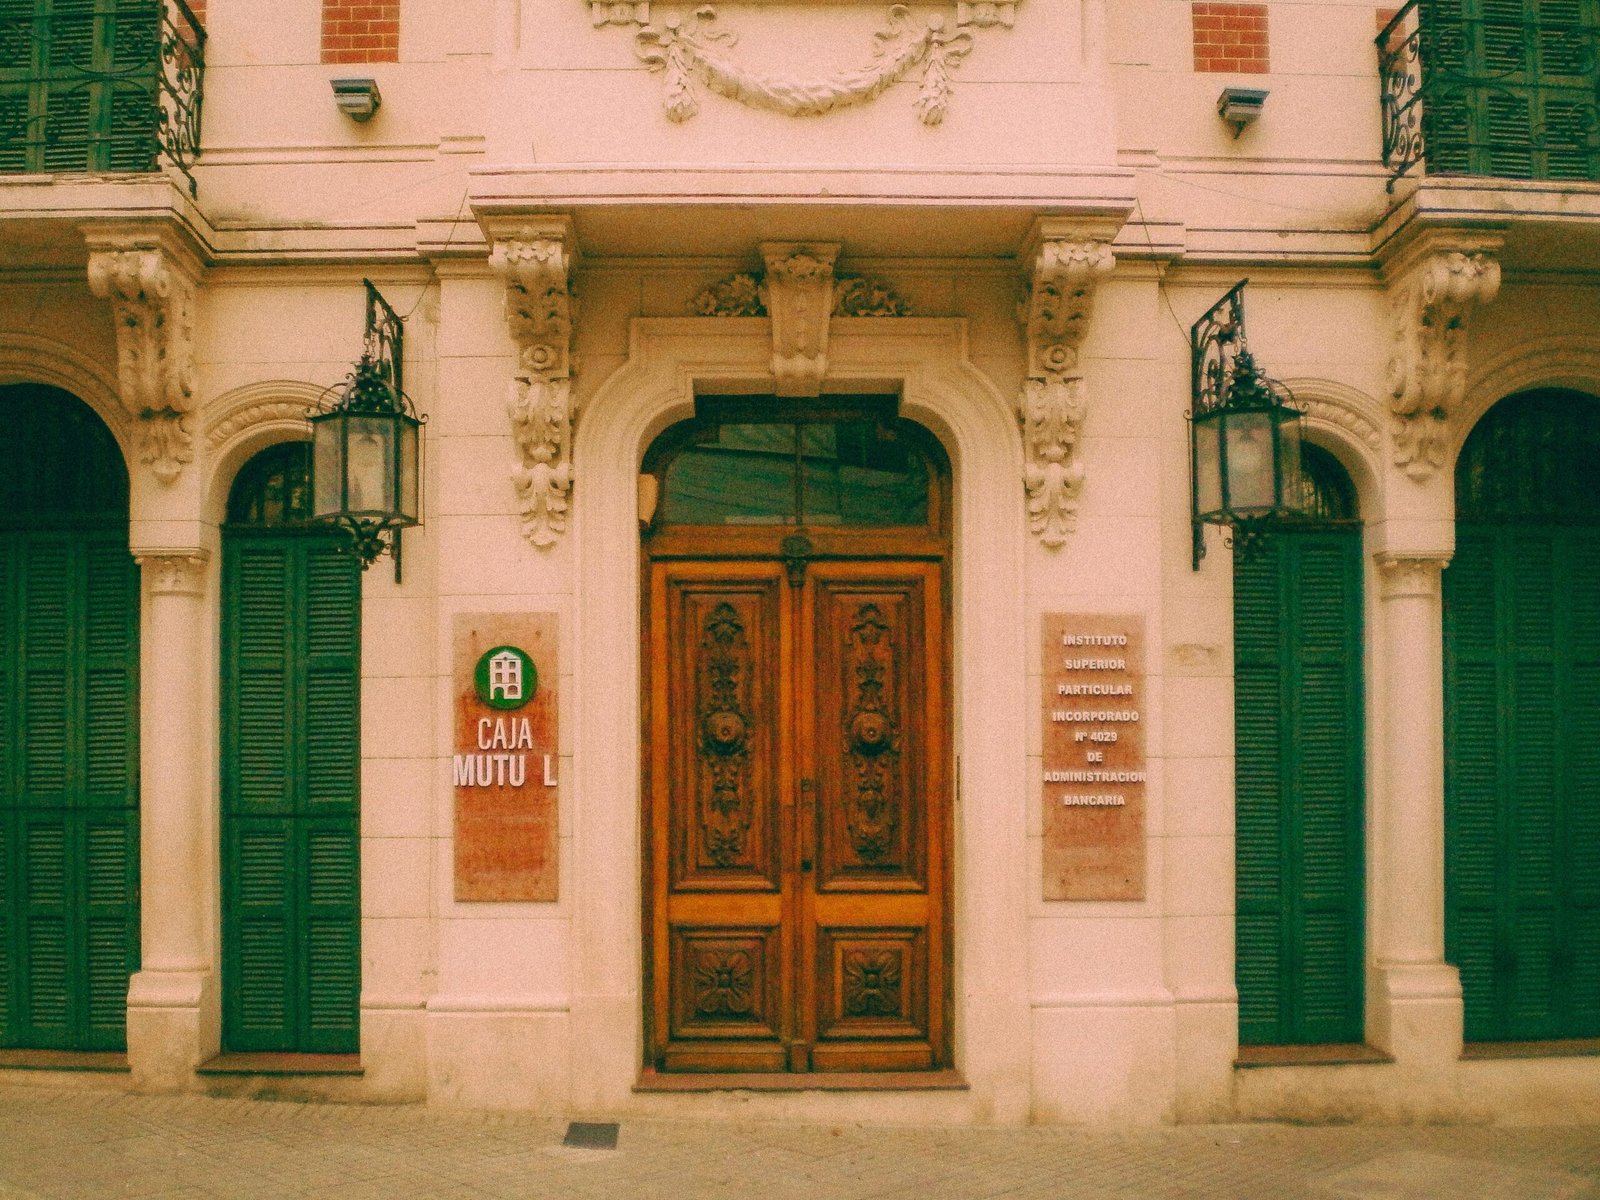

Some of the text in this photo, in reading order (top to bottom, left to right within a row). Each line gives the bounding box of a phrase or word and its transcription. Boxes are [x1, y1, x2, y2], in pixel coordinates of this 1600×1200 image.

[1063, 634, 1127, 646] INSTITUTO
[1065, 659, 1126, 670] SUPERIOR
[1058, 685, 1133, 695] PARTICULAR
[1052, 711, 1139, 722] INCORPORADO
[478, 717, 533, 750] CAJA
[1090, 731, 1118, 742] 4029
[1087, 751, 1103, 762] DE
[453, 754, 557, 787] MUTUL
[1044, 771, 1147, 782] ADMINISTRACION
[1063, 795, 1126, 806] BANCARIA
